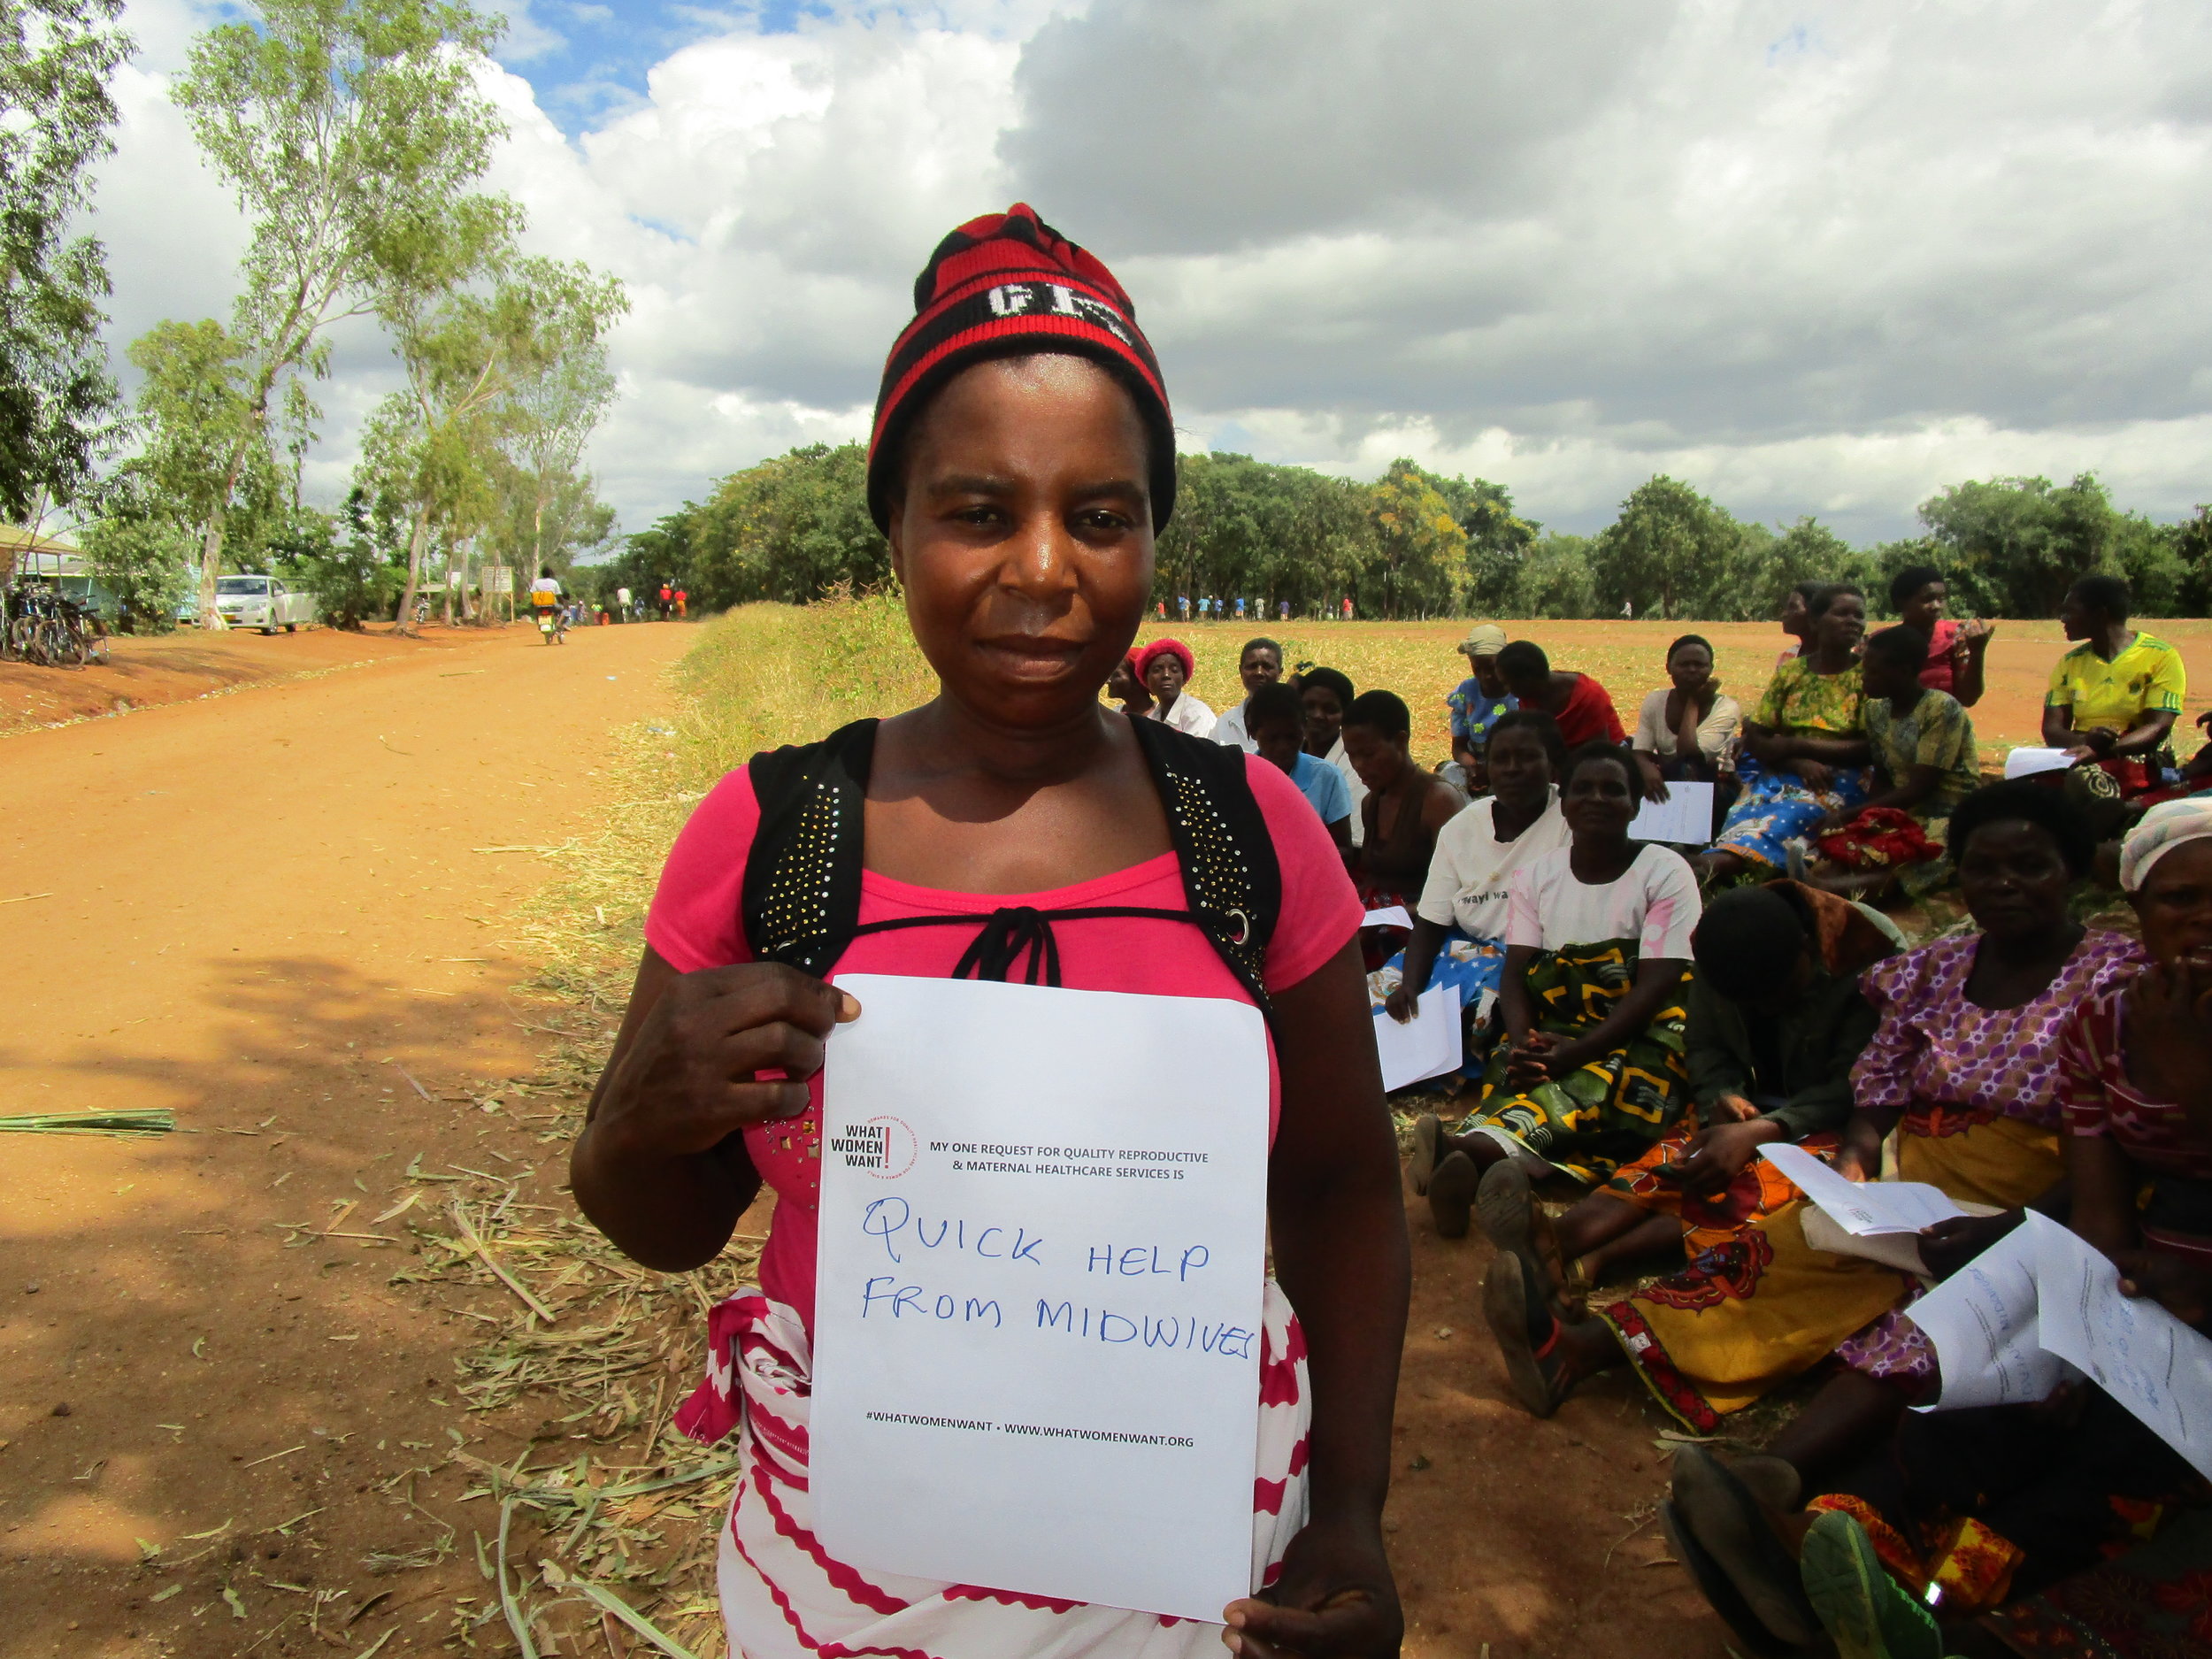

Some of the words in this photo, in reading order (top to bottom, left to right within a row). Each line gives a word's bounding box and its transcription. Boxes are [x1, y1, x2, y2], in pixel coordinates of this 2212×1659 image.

[846, 1125, 883, 1139] WHAT
[831, 1138, 883, 1154] WOMEN
[930, 1141, 949, 1152] MY
[952, 1142, 978, 1154] ONE
[980, 1144, 1033, 1156] REQUEST
[1037, 1147, 1060, 1157] FOR
[1064, 1148, 1115, 1160] QUALITY
[1118, 1149, 1209, 1164] REPRODUCTIVE
[845, 1154, 882, 1168] WANT
[952, 1160, 963, 1171] &
[966, 1161, 1032, 1173] MATERNAL
[1035, 1164, 1112, 1177] HEALTHCARE
[1116, 1167, 1170, 1179] SERVICES
[1172, 1170, 1184, 1179] IS
[863, 1196, 1043, 1265] QUICK
[1087, 1244, 1210, 1282] HELP
[863, 1276, 1002, 1328] FROM
[1036, 1298, 1256, 1360] MIDWIVES
[866, 1411, 993, 1432] #WHATWOMENWANT
[1004, 1423, 1194, 1448] WWW.WHATWOMENWANT.ORG
